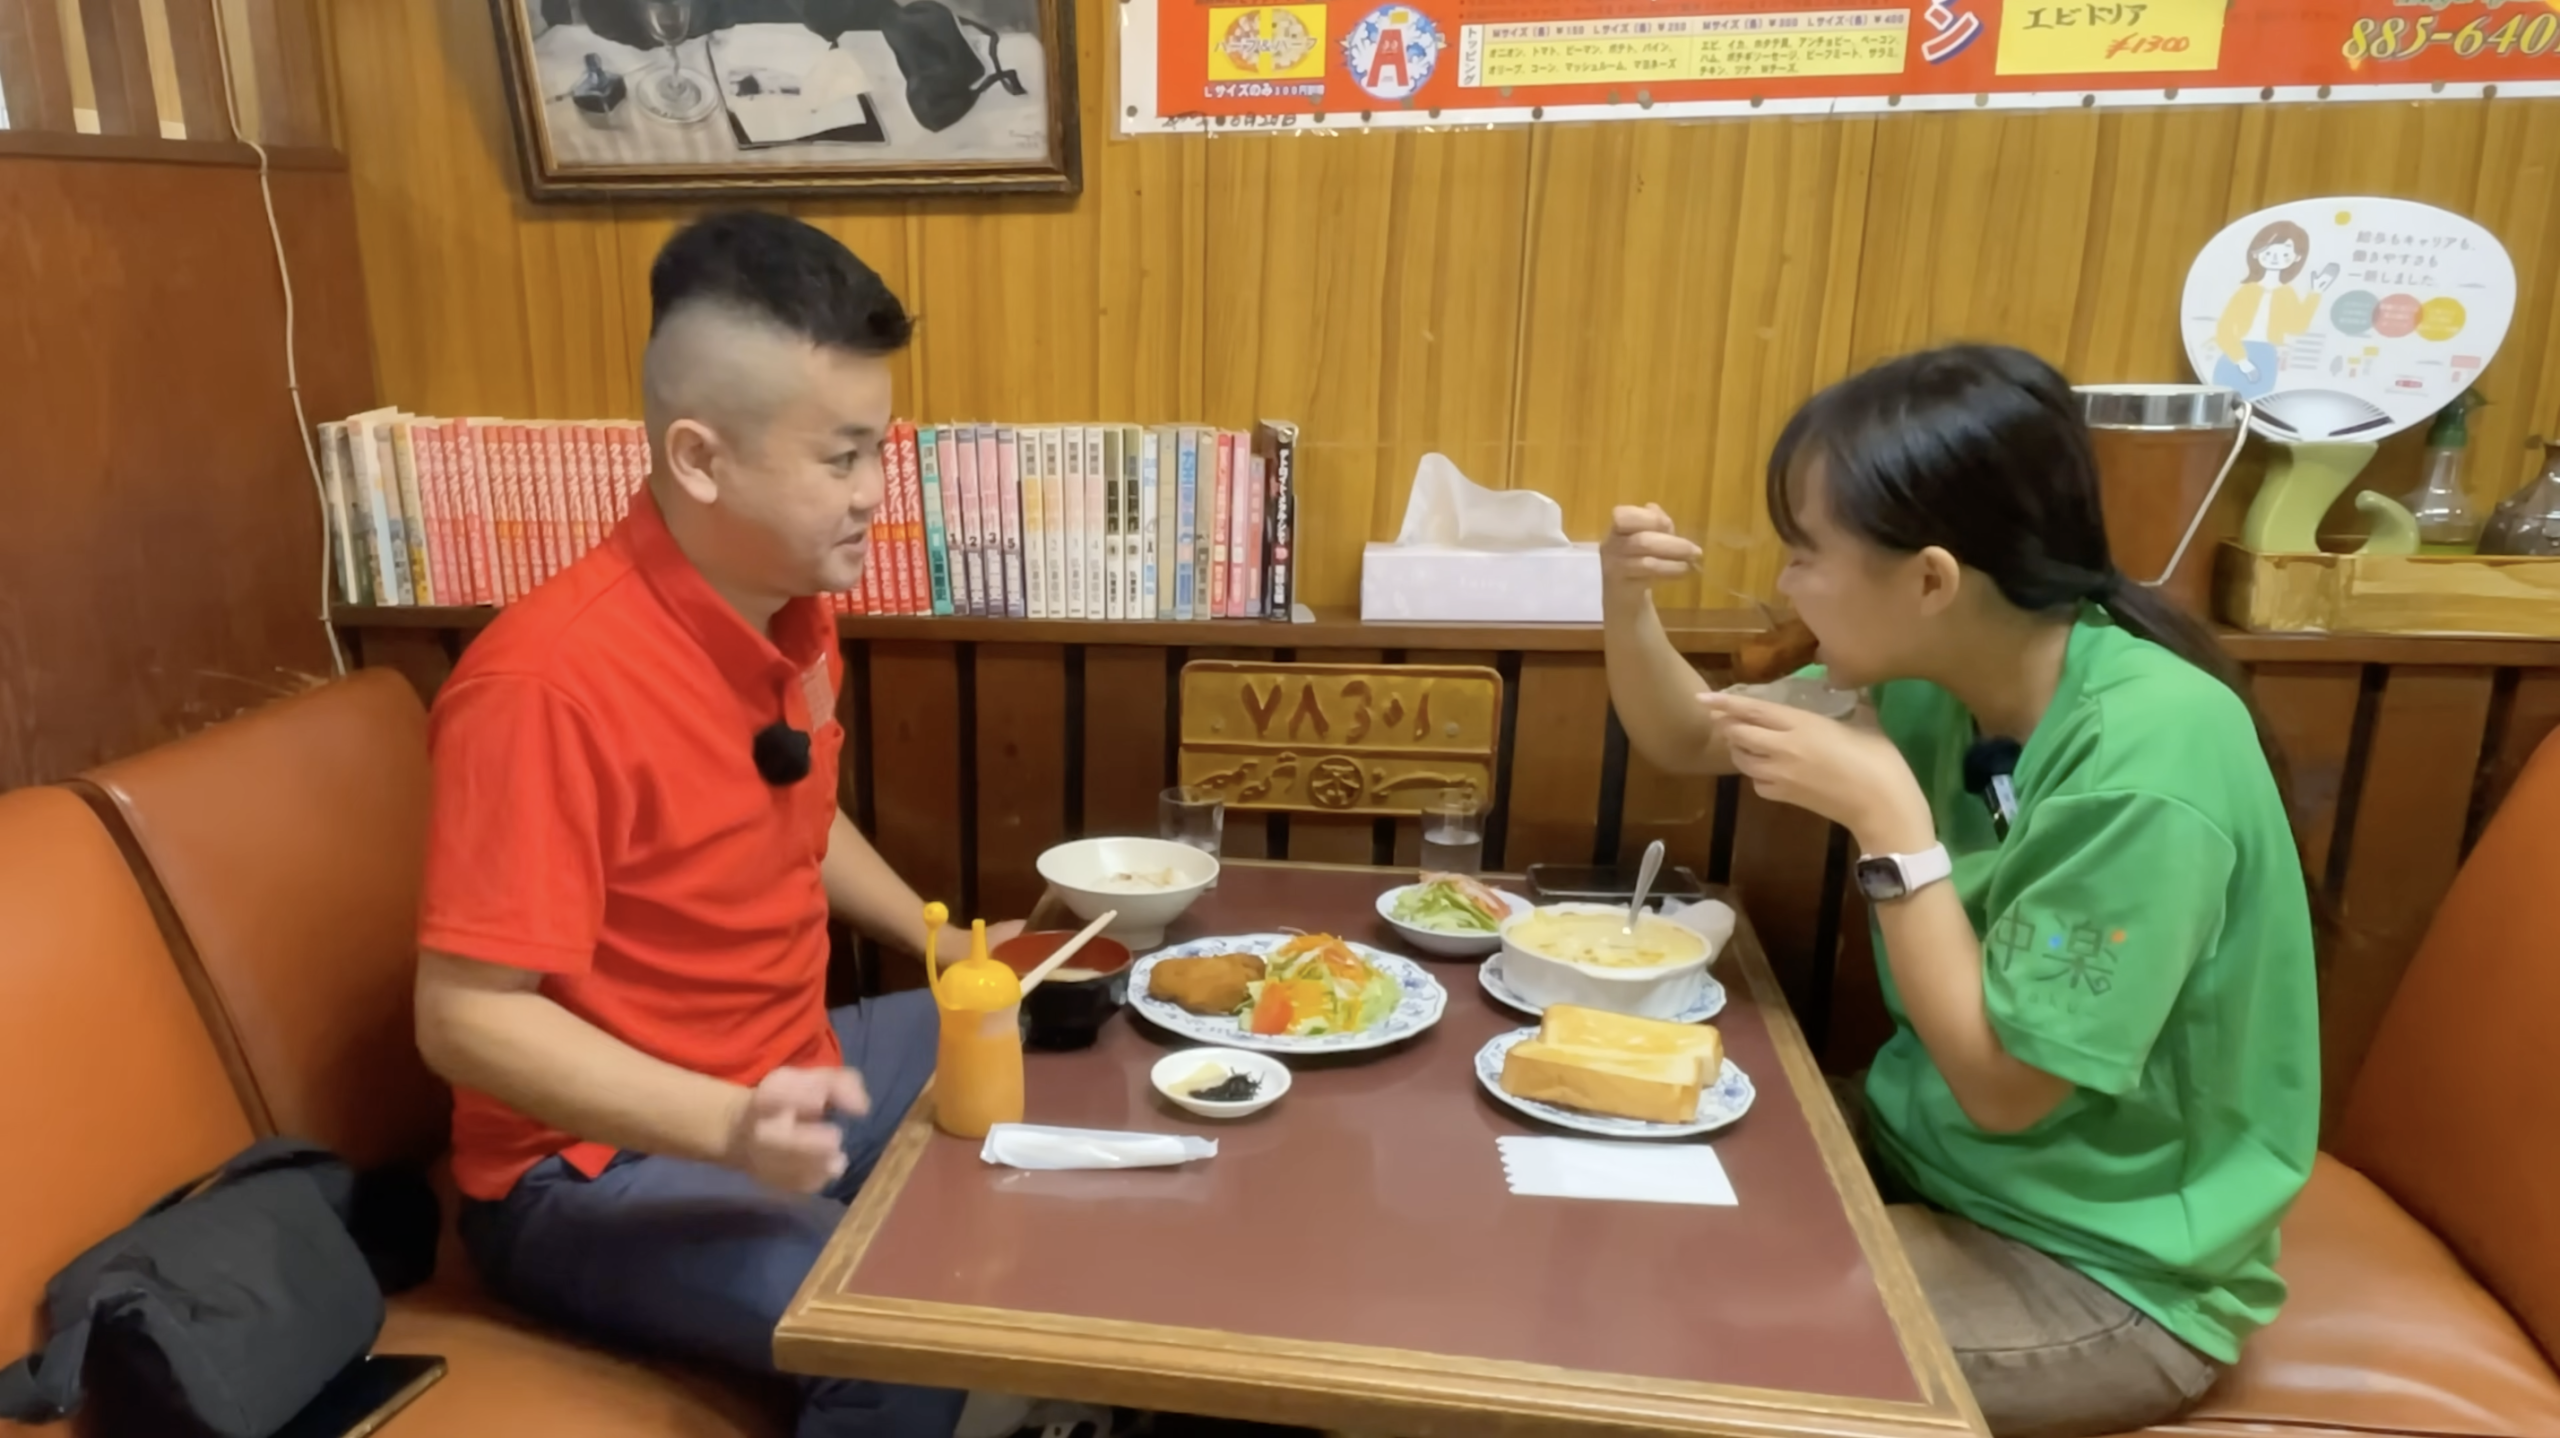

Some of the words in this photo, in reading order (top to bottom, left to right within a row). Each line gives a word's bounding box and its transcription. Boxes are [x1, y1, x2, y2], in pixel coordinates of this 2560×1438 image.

[2341, 13, 2560, 59] 885-640
[1463, 27, 1478, 86] トッピング
[950, 534, 957, 545] 1
[969, 536, 978, 547] 2
[988, 533, 997, 544] 3
[1007, 538, 1016, 549] 5
